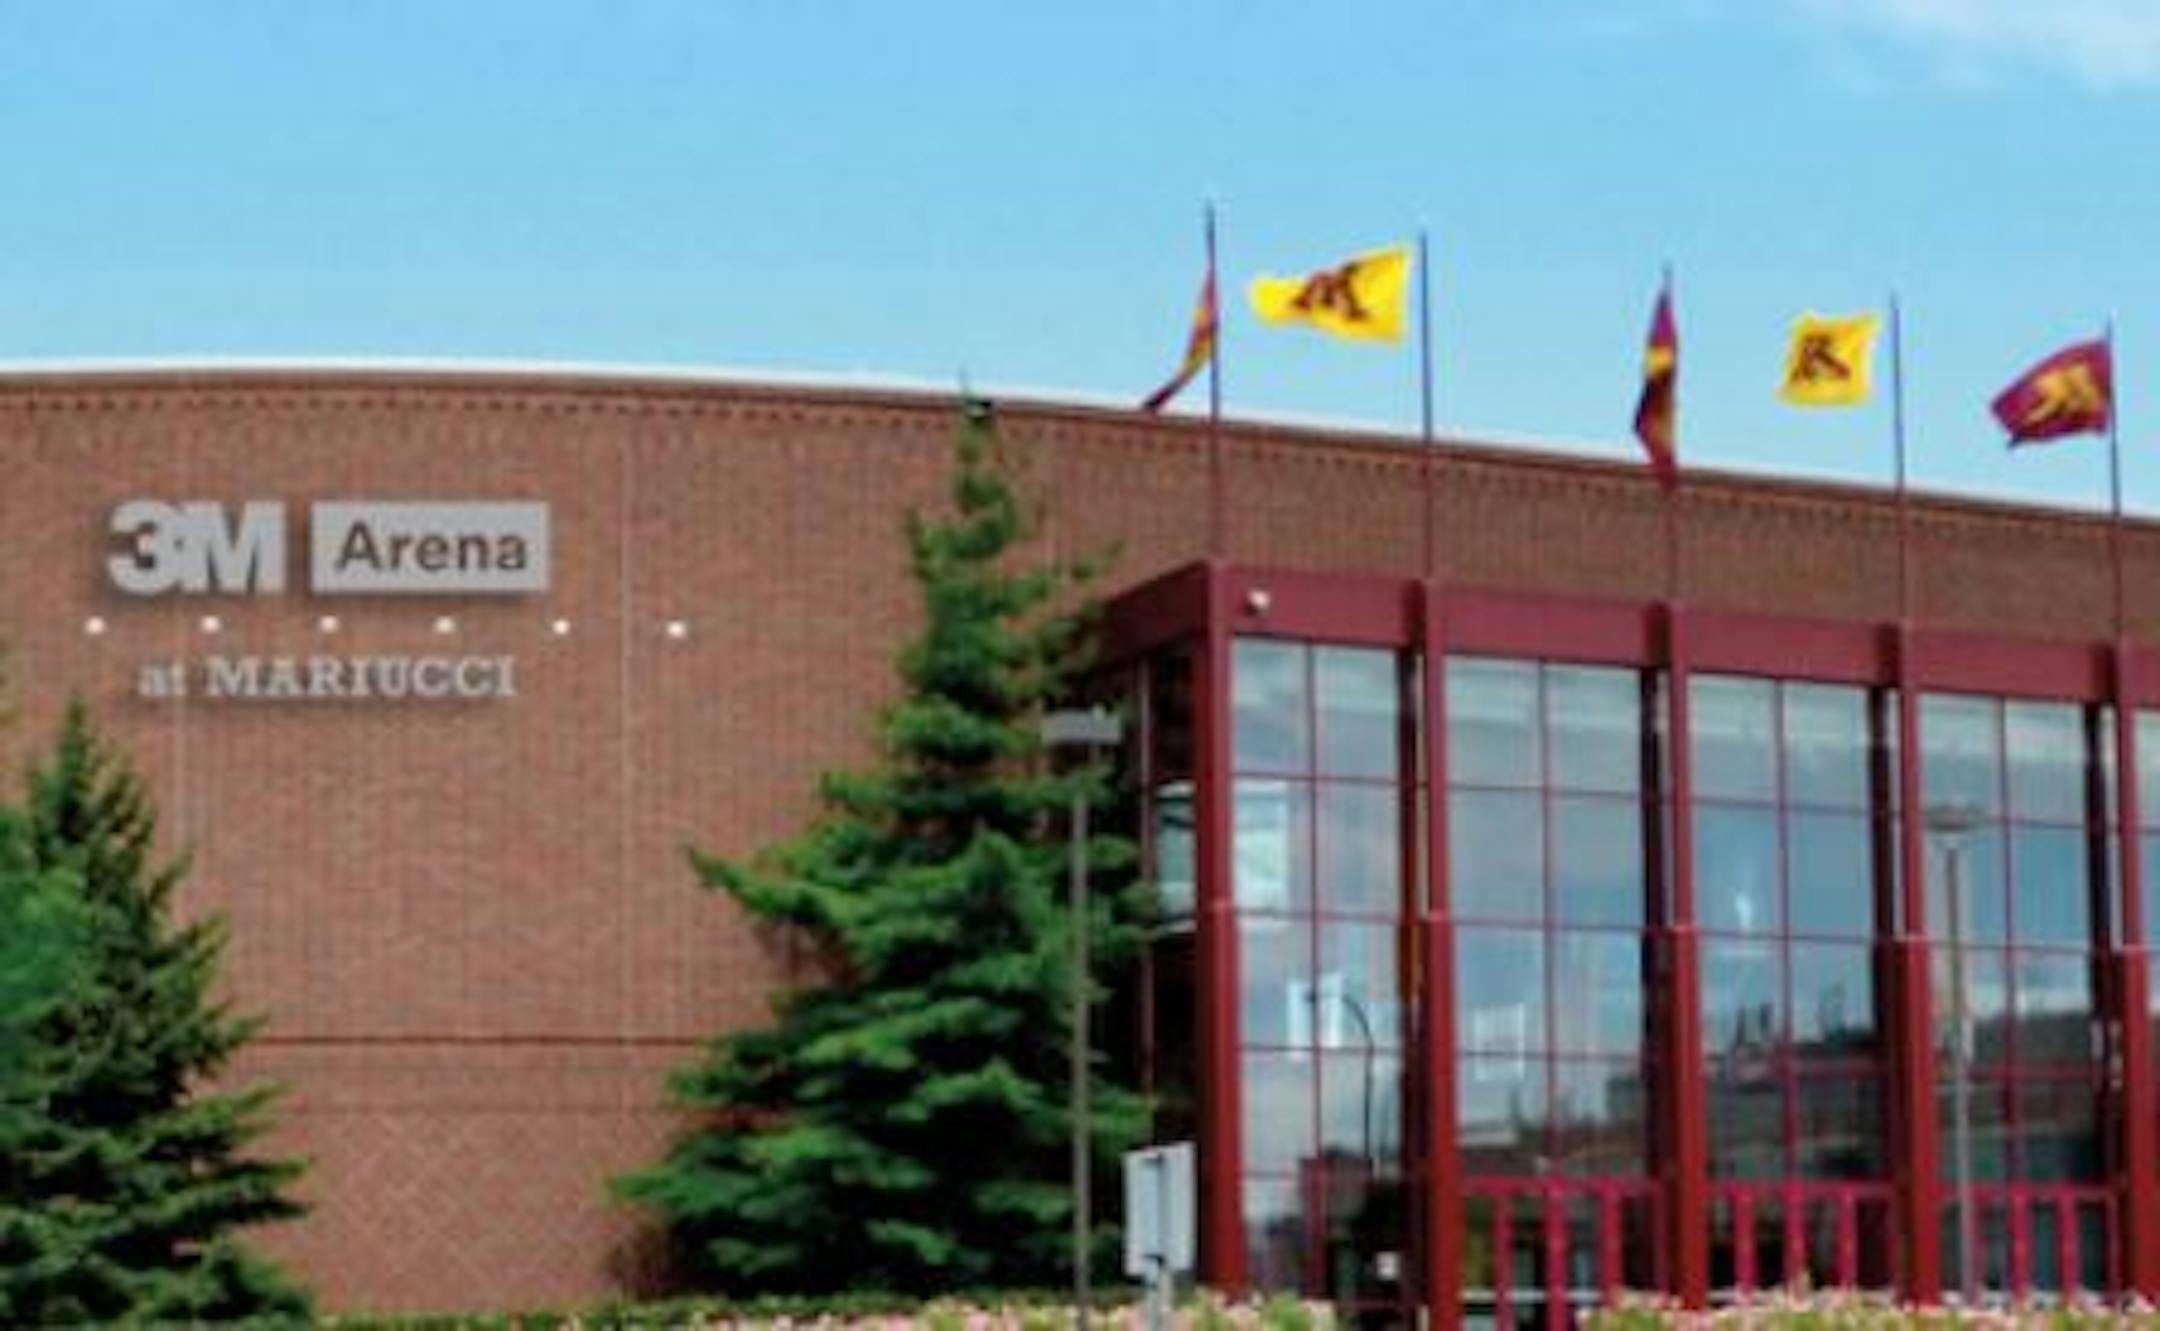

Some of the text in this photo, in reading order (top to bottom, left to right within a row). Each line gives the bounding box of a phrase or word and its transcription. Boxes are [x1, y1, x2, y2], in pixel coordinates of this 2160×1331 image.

[107, 500, 528, 595] 3M Arena
[138, 655, 516, 698] at MARIUCCI
